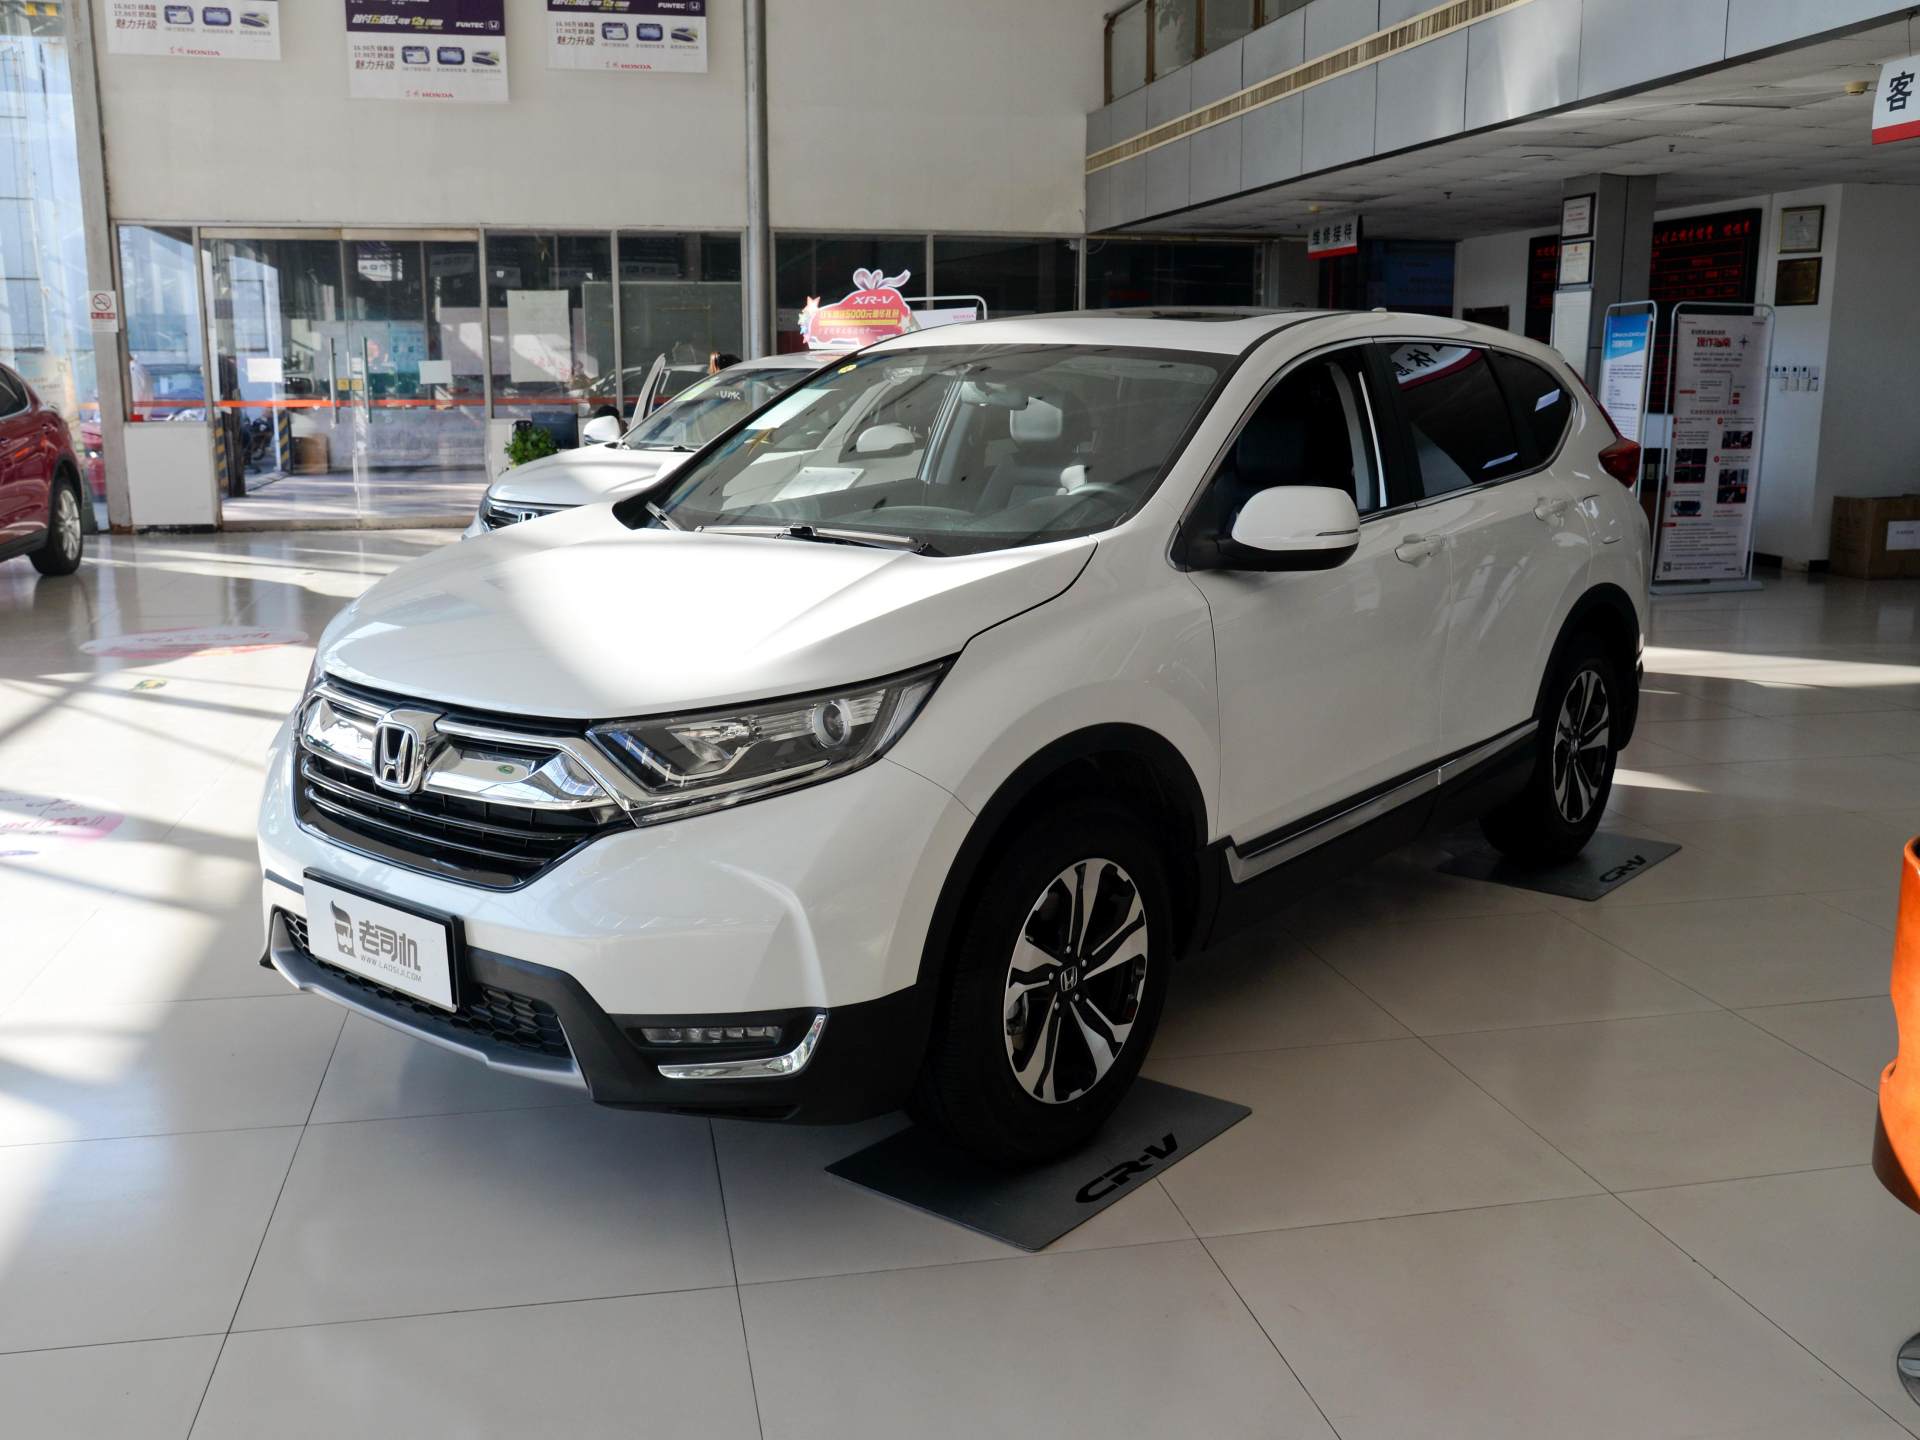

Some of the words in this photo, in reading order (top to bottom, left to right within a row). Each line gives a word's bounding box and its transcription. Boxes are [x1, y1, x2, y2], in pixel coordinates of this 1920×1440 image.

[115, 19, 157, 29] 魅力升级
[557, 35, 595, 46] 魅力升级
[355, 60, 395, 70] 魅力升级
[1886, 71, 1915, 112] 客
[852, 295, 894, 304] XR-V
[1599, 854, 1647, 883] CR-V
[358, 920, 421, 972] 老司机
[1074, 1132, 1178, 1204] CR-V
